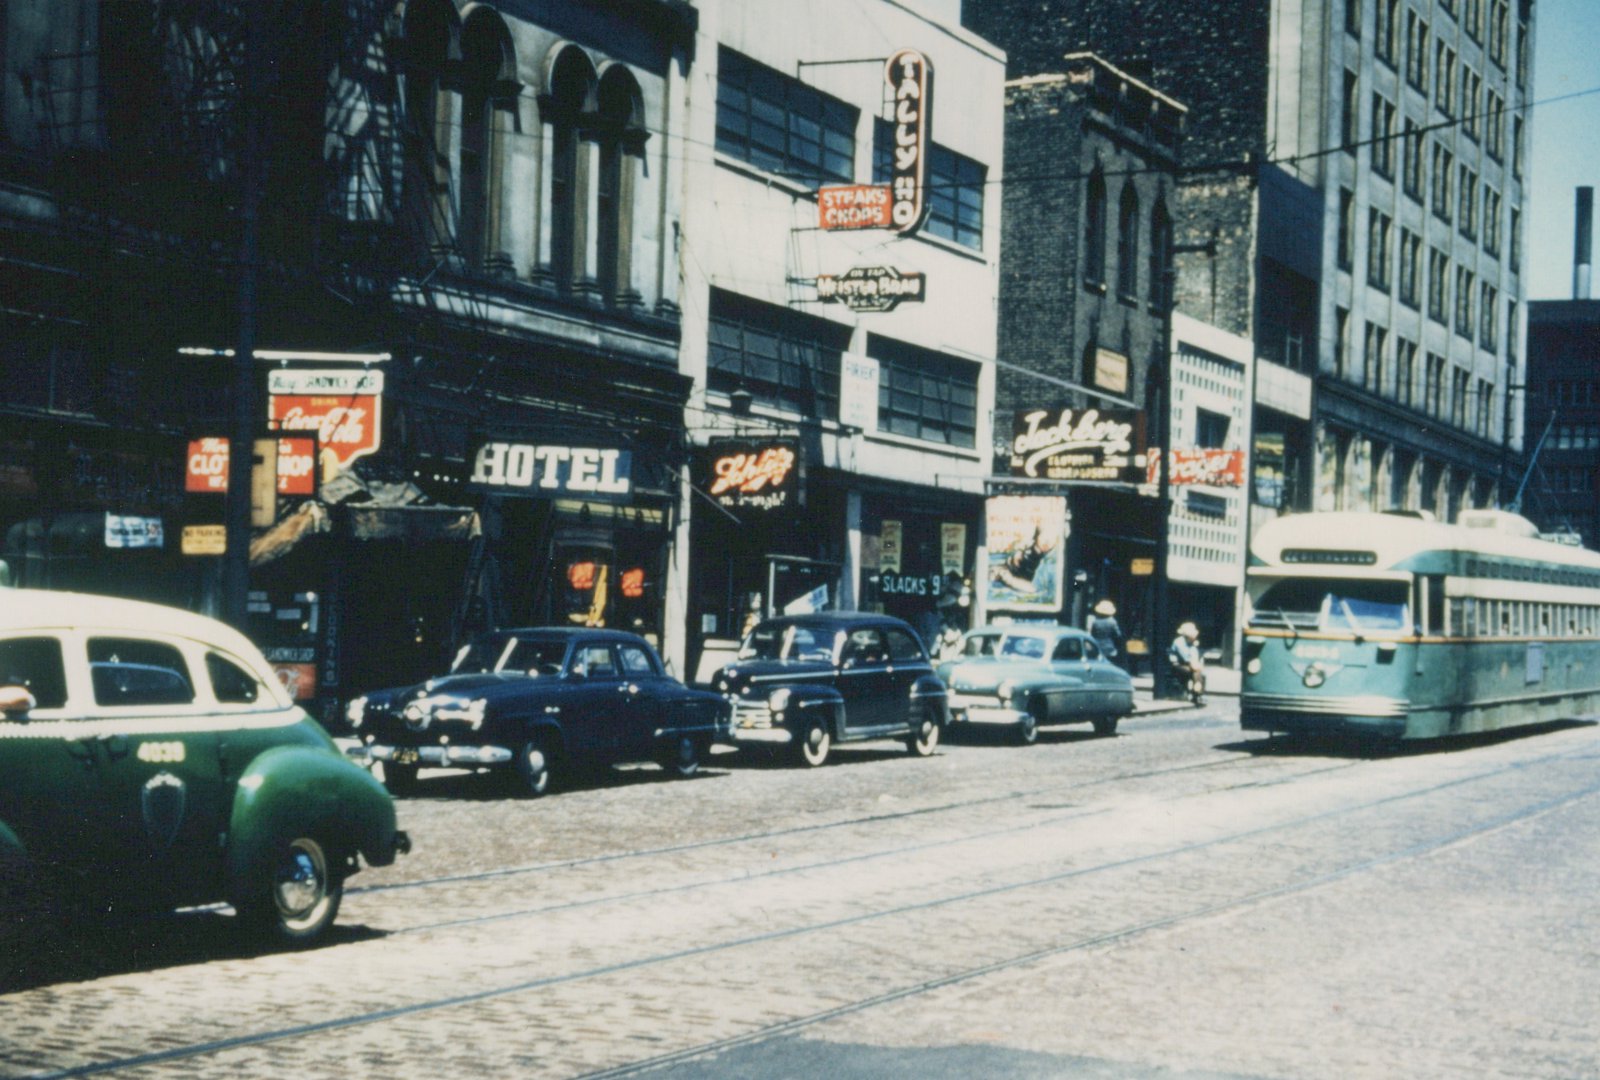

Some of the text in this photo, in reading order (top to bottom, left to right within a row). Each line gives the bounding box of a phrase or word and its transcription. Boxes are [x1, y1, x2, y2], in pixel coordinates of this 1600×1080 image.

[892, 53, 920, 226] TALLY HO
[822, 187, 888, 208] STEAKS
[824, 207, 884, 226] CHOPS
[867, 269, 886, 277] TAP
[470, 443, 629, 494] HOTEL
[882, 575, 927, 596] SLACKS
